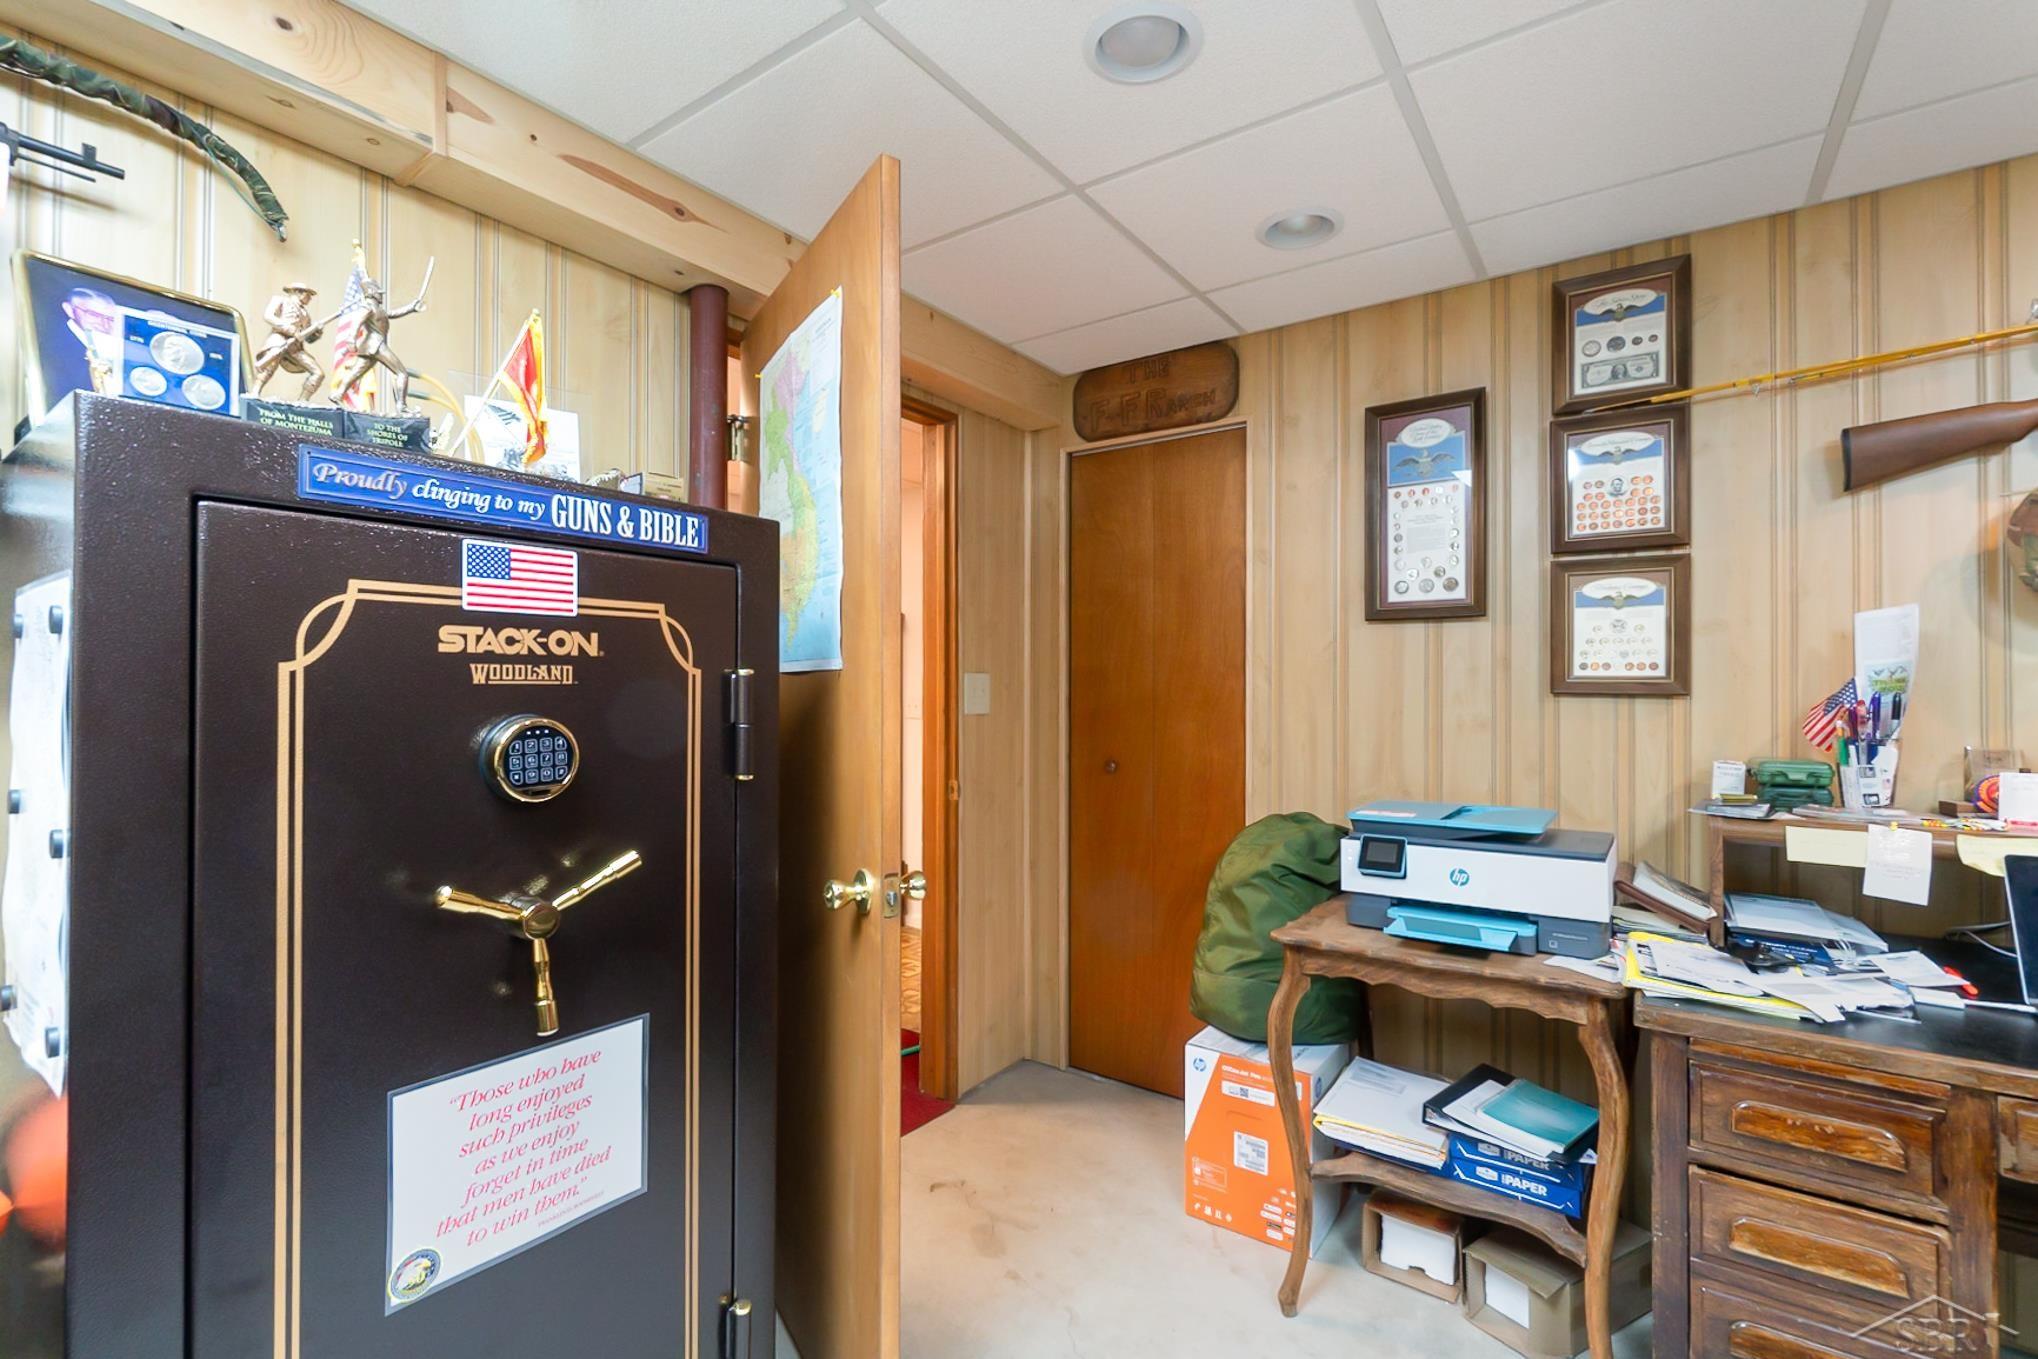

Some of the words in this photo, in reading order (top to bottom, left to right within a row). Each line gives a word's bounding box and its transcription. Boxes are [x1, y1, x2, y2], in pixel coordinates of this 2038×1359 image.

[258, 408, 286, 420] FROM
[288, 413, 306, 424] THE
[307, 417, 334, 430] HALLS
[260, 417, 273, 426] OF
[275, 419, 333, 436] MONTEZUMA
[374, 423, 385, 431] TO
[386, 424, 401, 433] THE
[312, 462, 407, 500] Proudly
[412, 478, 491, 513] clinging
[495, 494, 514, 510] to
[517, 500, 546, 521] my
[551, 493, 612, 535] GUNS
[616, 505, 635, 538] &
[639, 508, 699, 548] BIBLE
[437, 624, 600, 657] STACK-ON
[469, 663, 574, 685] WOODLAND
[1450, 867, 1470, 887] hp
[518, 1066, 557, 1090] who
[561, 1050, 602, 1074] have
[469, 1103, 513, 1131] long
[517, 1073, 586, 1112] enjoyed
[458, 1127, 505, 1158] such
[508, 1095, 593, 1144] privileges
[474, 1155, 497, 1175] as
[501, 1143, 528, 1164] we
[531, 1120, 580, 1150] enjoy
[436, 1205, 478, 1238] that
[482, 1187, 525, 1216] men
[530, 1167, 572, 1196] have
[574, 1145, 612, 1175] died
[460, 1165, 521, 1209] forget
[526, 1157, 545, 1175] in
[549, 1138, 589, 1165] time
[1507, 1173, 1548, 1197] PAPER
[466, 1228, 488, 1247] to
[492, 1207, 529, 1235] win
